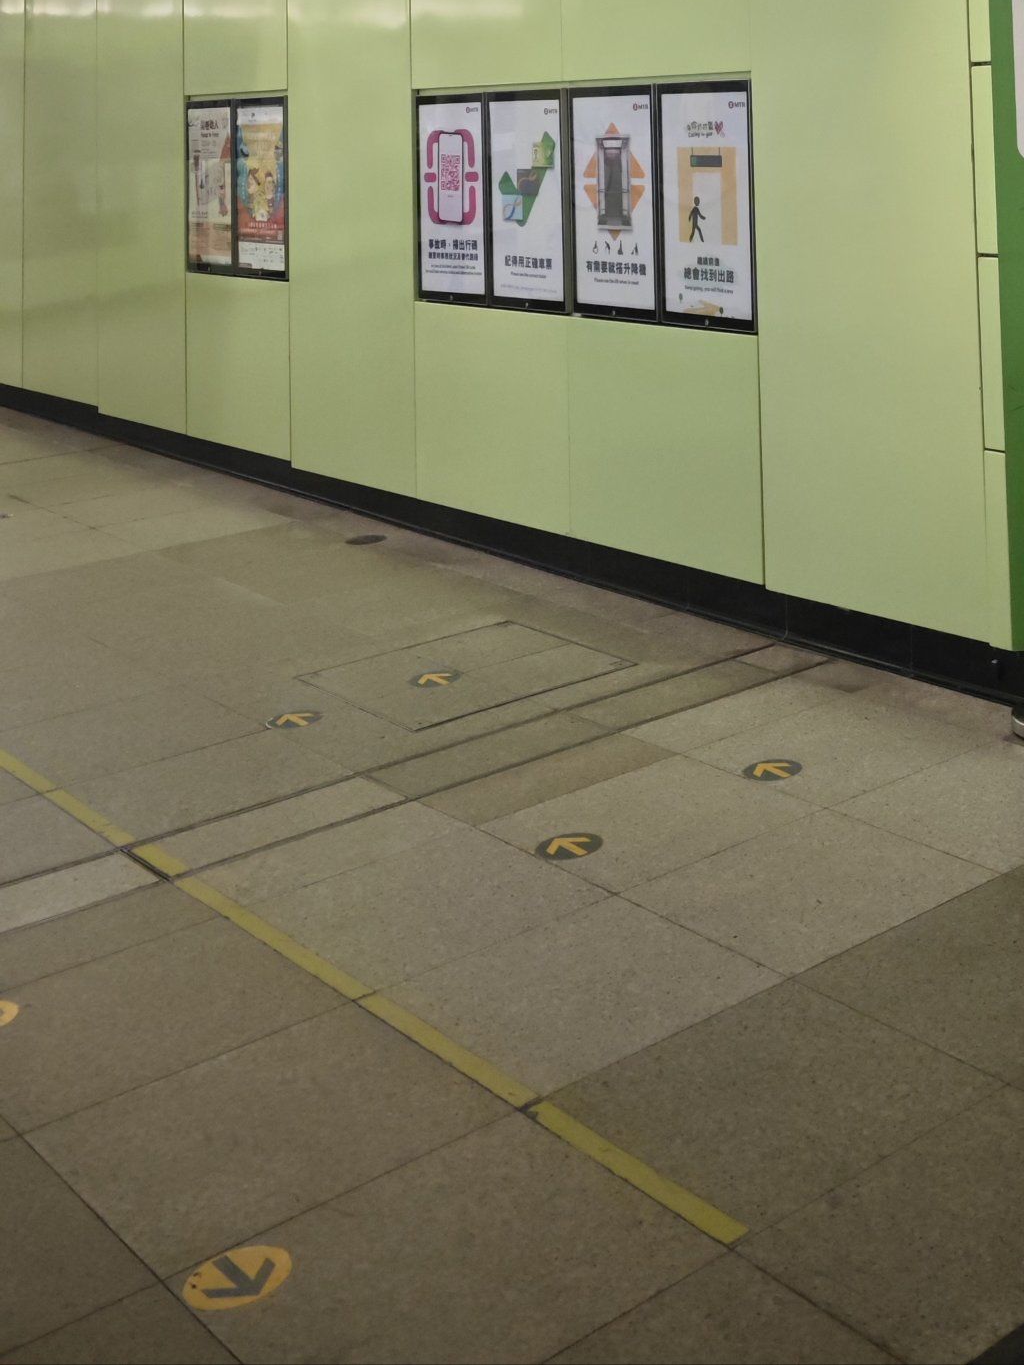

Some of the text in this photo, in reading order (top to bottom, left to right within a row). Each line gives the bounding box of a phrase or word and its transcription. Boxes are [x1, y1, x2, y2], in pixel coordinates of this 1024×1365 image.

[683, 266, 735, 284] 總會找到出路
